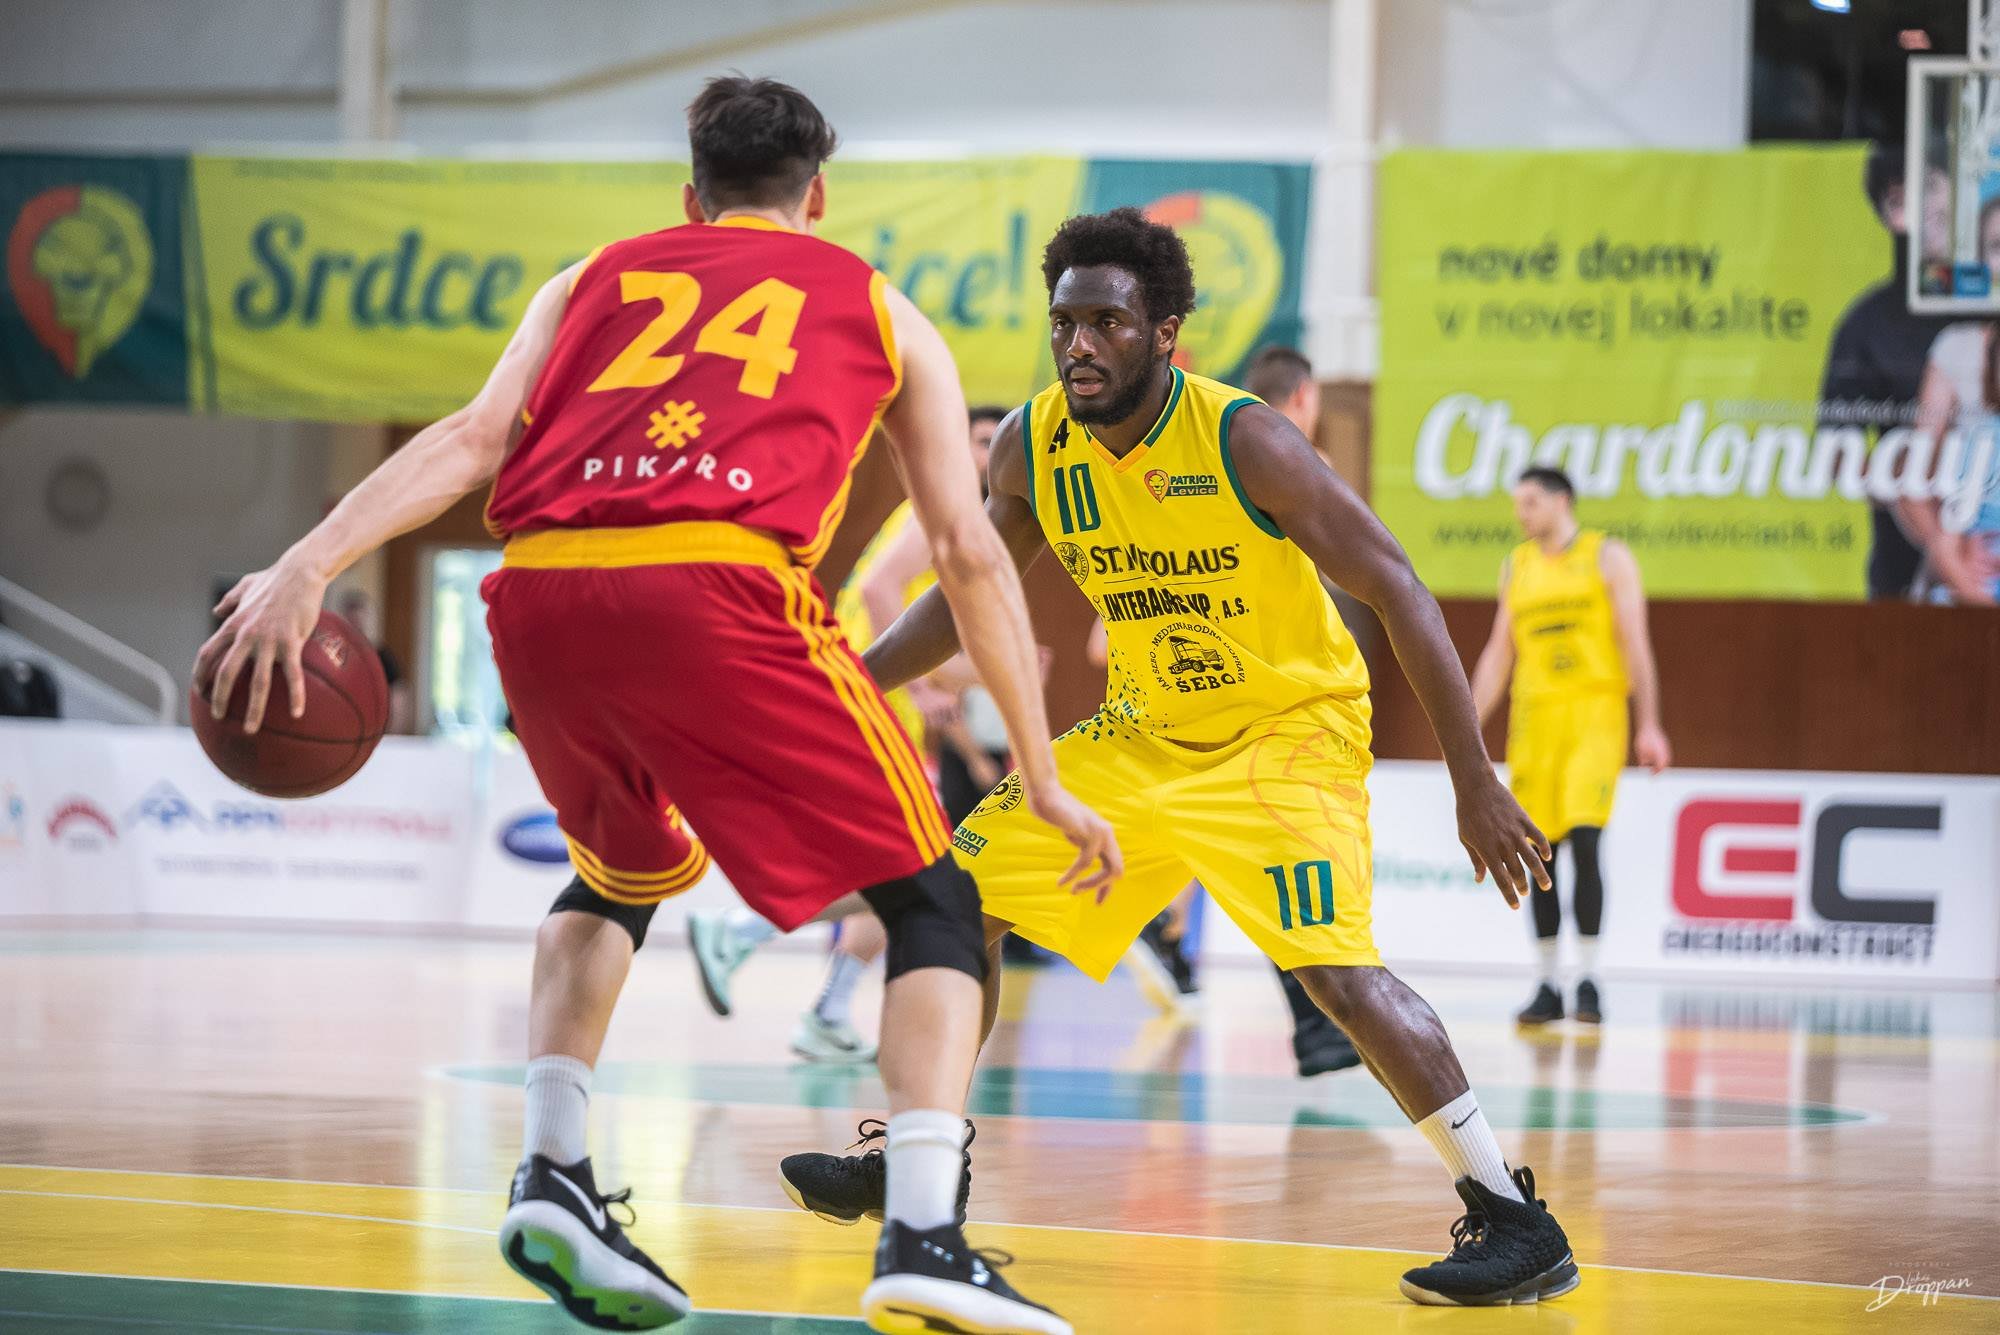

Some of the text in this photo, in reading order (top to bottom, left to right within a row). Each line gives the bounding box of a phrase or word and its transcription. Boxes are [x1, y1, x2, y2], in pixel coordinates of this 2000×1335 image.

[232, 212, 1027, 332] Srdce ice!
[1438, 233, 1720, 288] nové domy
[585, 271, 807, 400] 24
[1436, 292, 1809, 347] v novej lokalite
[1413, 392, 1996, 534] Chardonnay
[1053, 462, 1102, 535] 10
[1170, 486, 1216, 496] Levice
[1089, 545, 1123, 575] ST.
[1222, 596, 1250, 619] A.S.
[1175, 673, 1237, 693] ŠEBO
[999, 773, 1022, 811] OVAKIA
[1671, 799, 1943, 925] EC
[1263, 860, 1335, 932] 10
